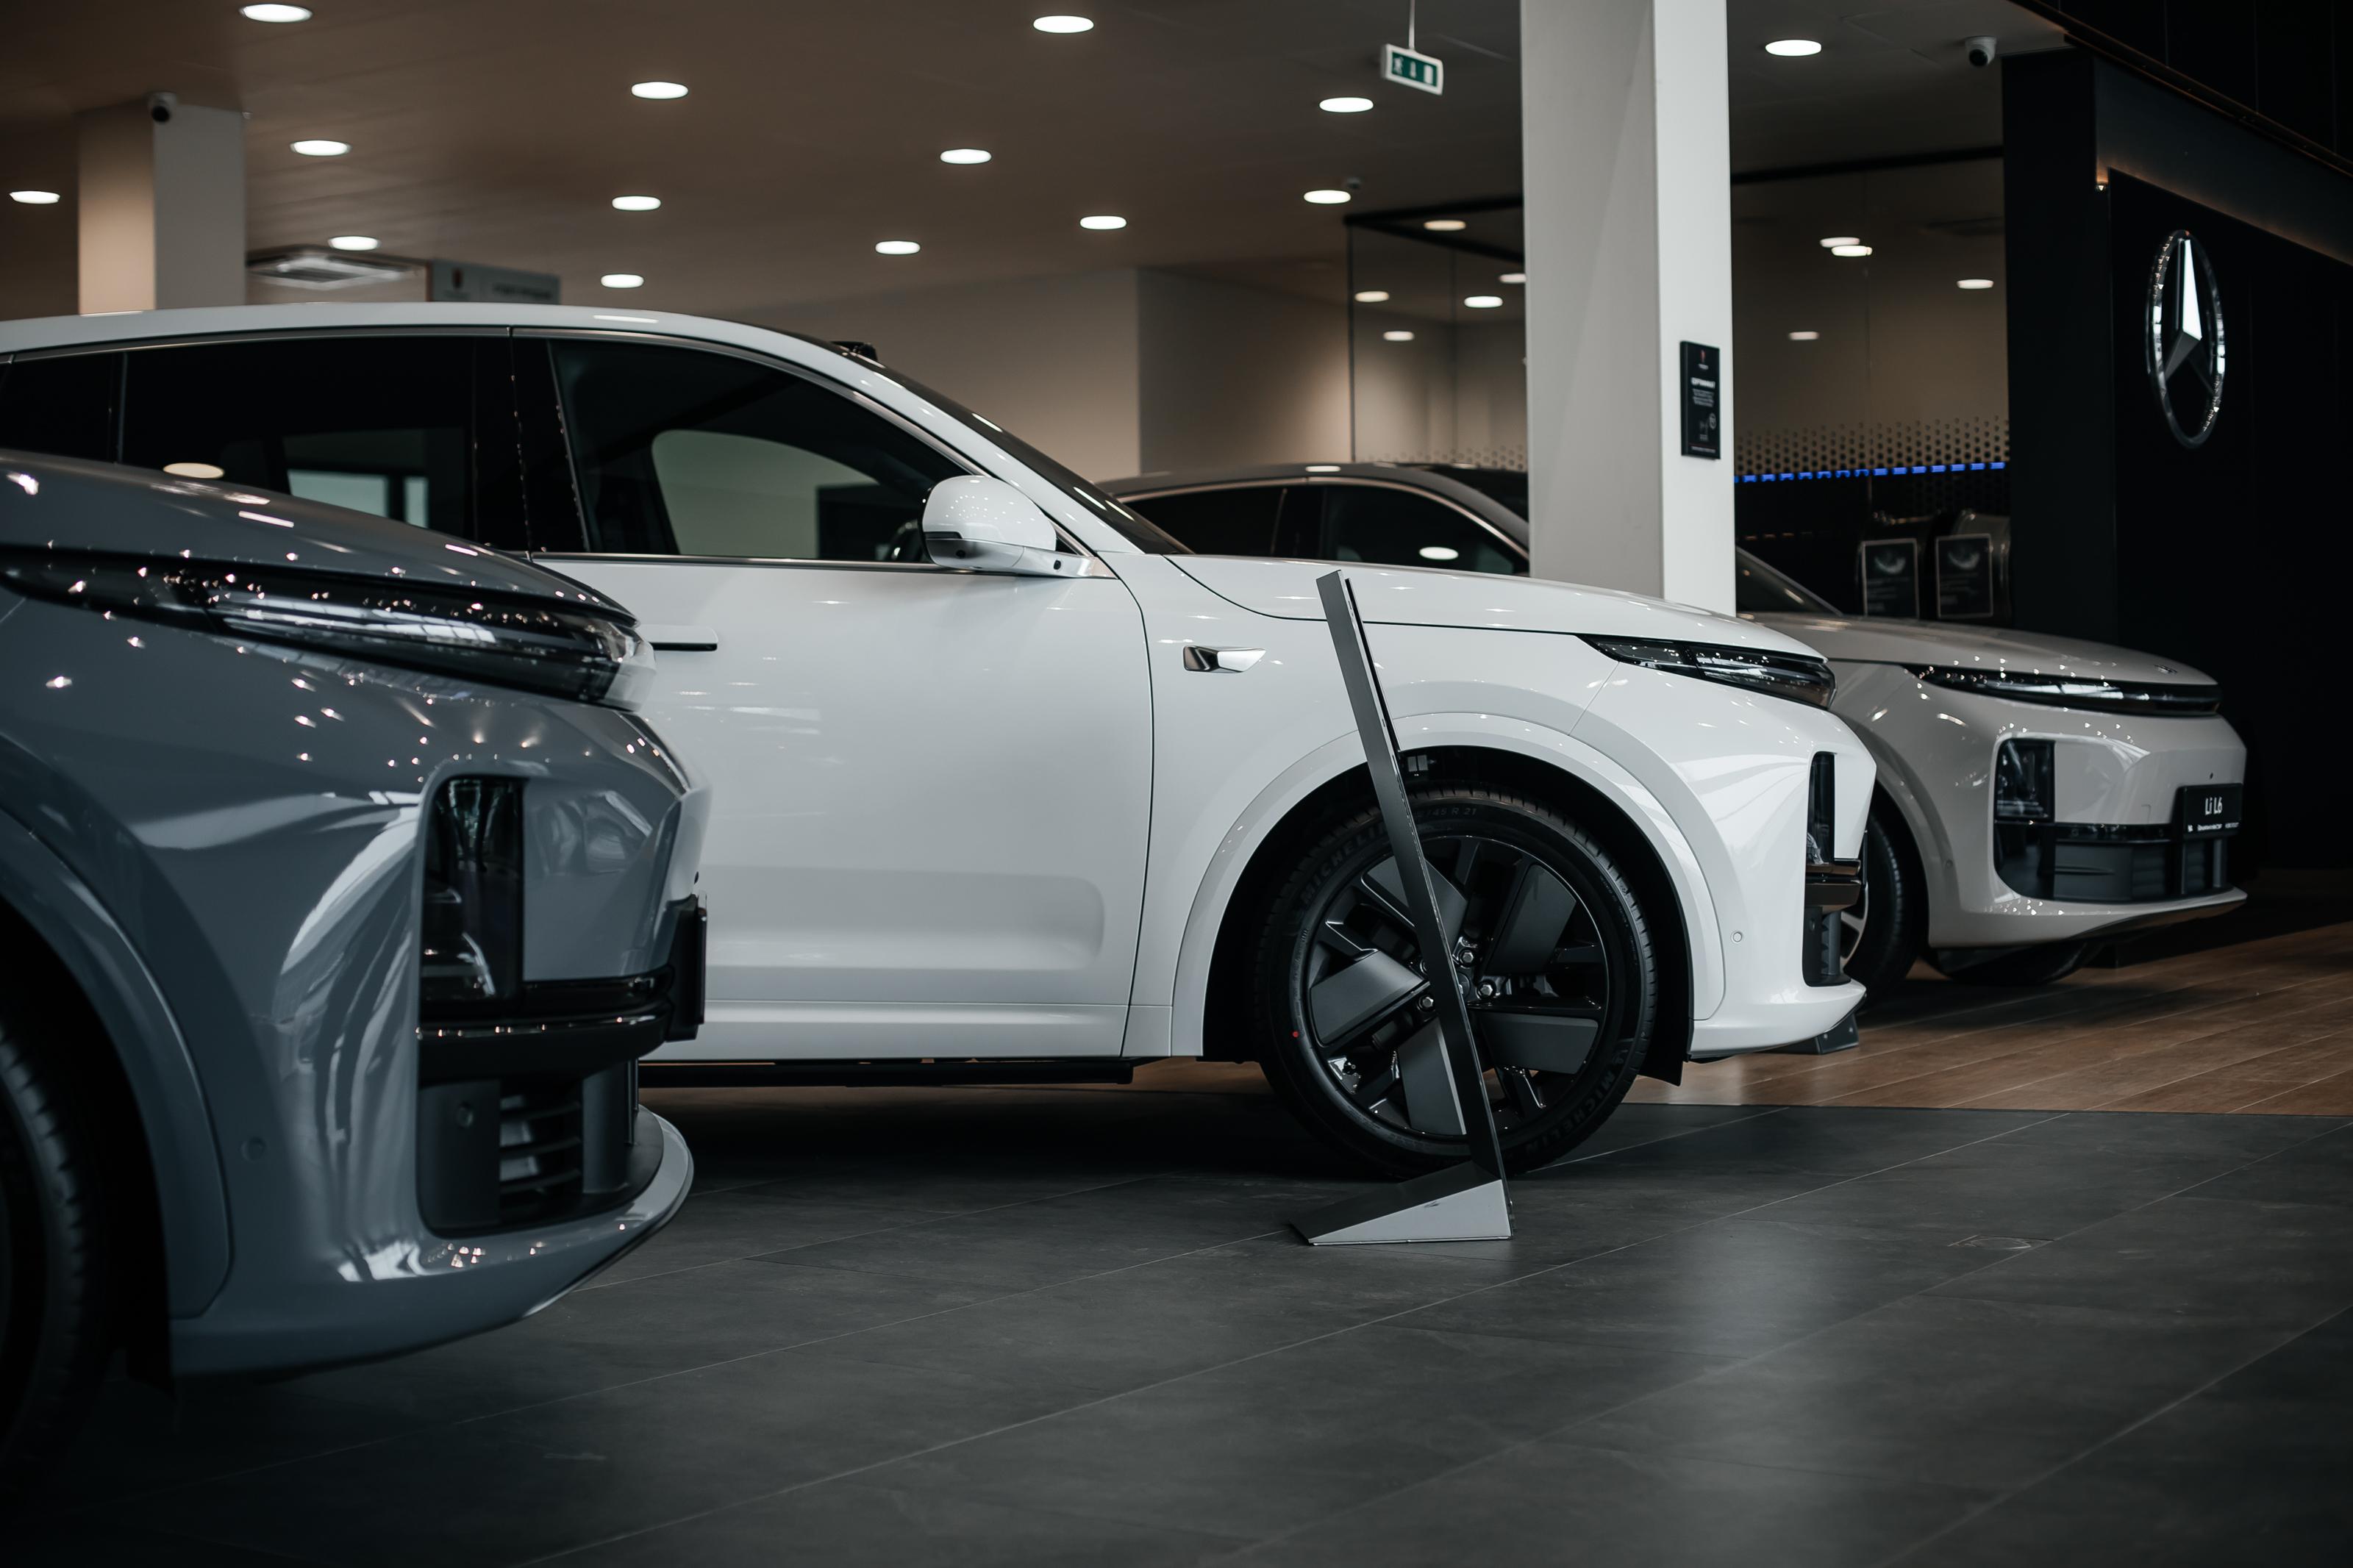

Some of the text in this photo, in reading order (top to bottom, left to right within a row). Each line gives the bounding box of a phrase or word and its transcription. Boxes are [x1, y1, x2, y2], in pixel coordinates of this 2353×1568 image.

[1452, 806, 1460, 815] R
[1464, 806, 1477, 816] 21
[2205, 796, 2223, 815] Li L6
